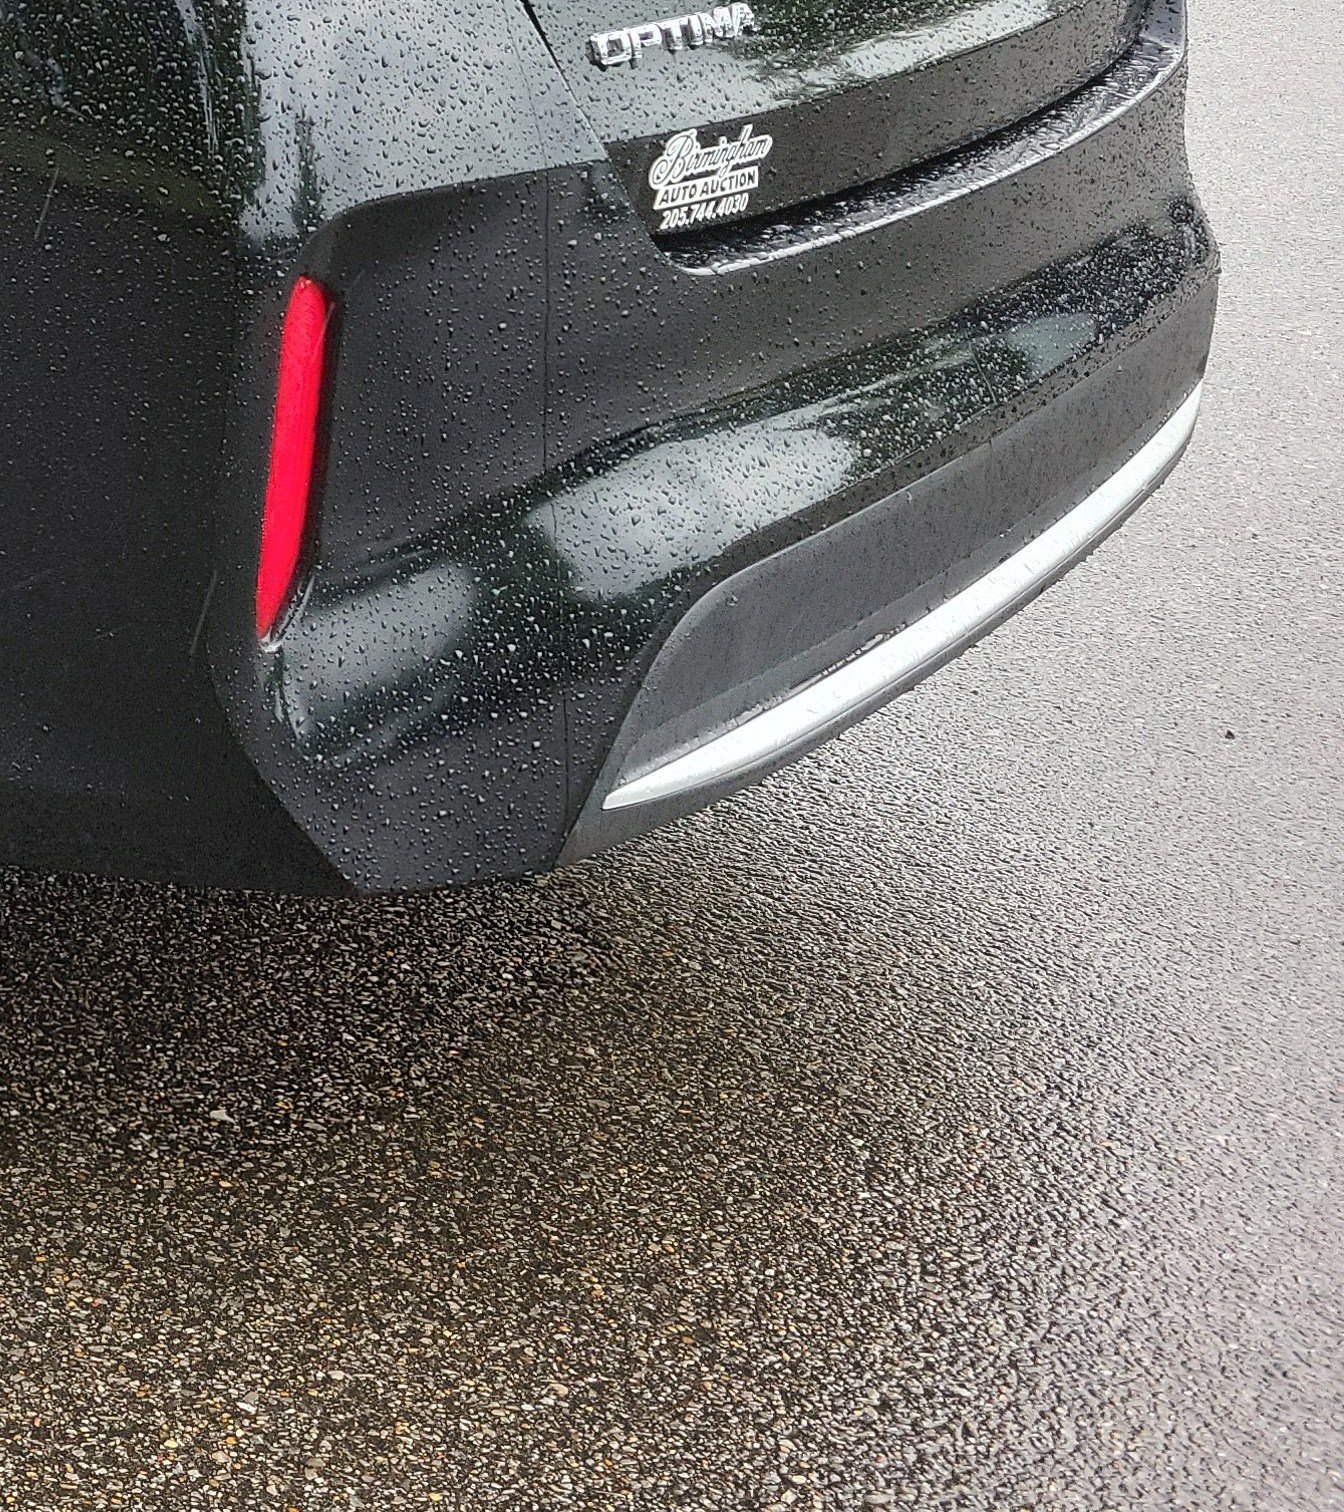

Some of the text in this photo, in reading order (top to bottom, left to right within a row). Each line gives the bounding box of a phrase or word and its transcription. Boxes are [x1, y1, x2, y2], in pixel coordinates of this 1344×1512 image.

[590, 1, 756, 66] OPTIMA
[651, 126, 772, 186] Birmingham
[660, 170, 757, 205] AUTO AUCTION
[660, 193, 749, 230] 205.744.4030
